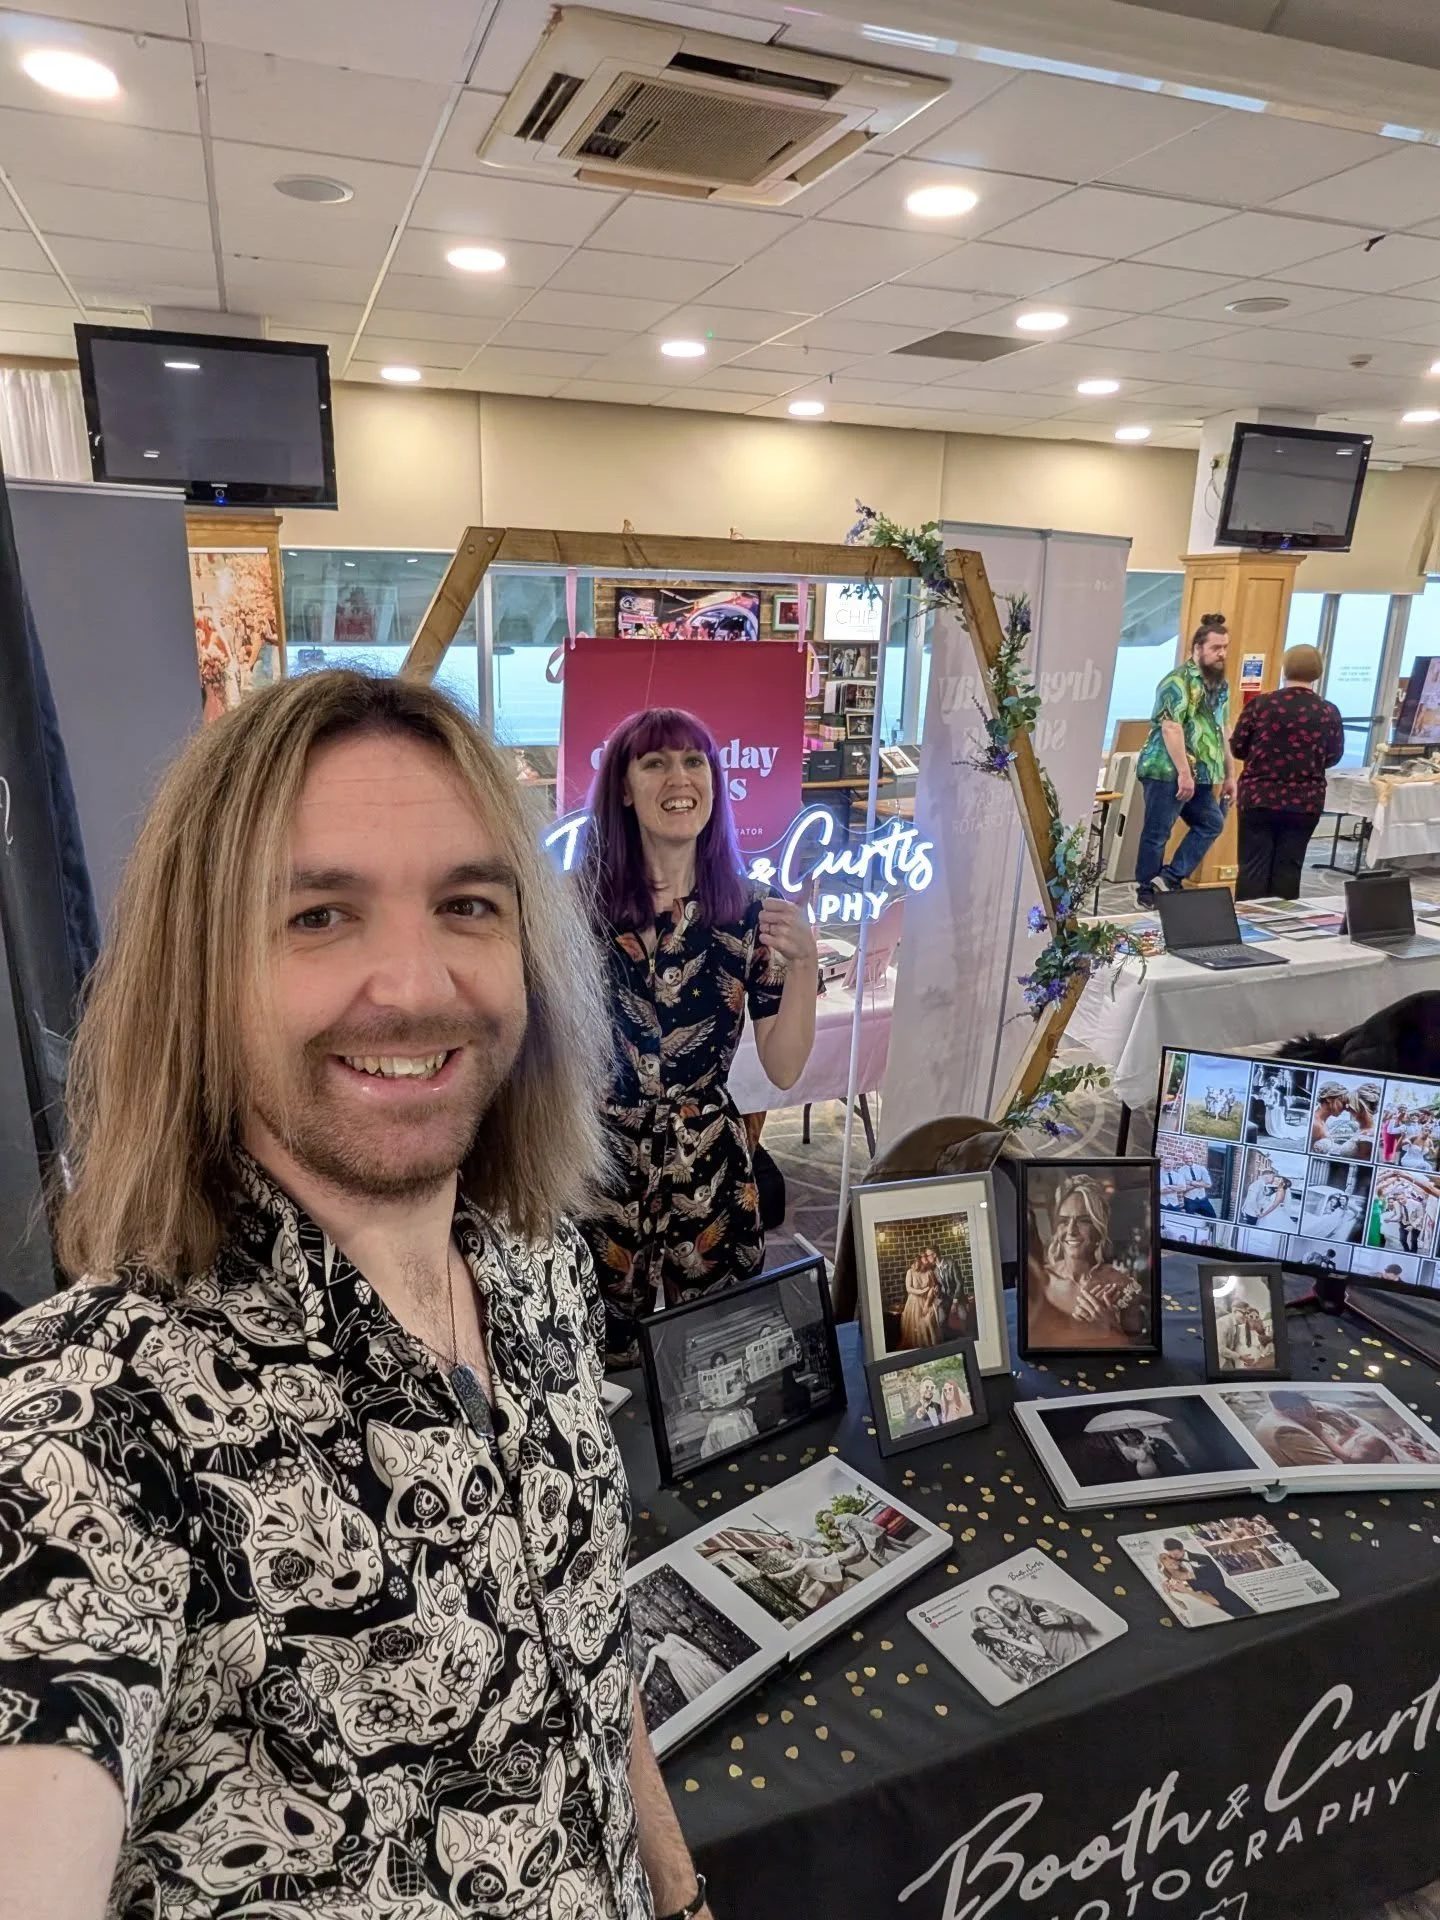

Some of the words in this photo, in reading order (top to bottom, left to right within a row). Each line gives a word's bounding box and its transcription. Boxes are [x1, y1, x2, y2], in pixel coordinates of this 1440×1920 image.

[719, 738, 779, 777] day
[780, 810, 934, 893] Curtis
[898, 1770, 1211, 1920] Booth
[1216, 1783, 1251, 1830] &
[1264, 1674, 1440, 1812] Curt
[1051, 1771, 1410, 1920] OTOGRAPHY
